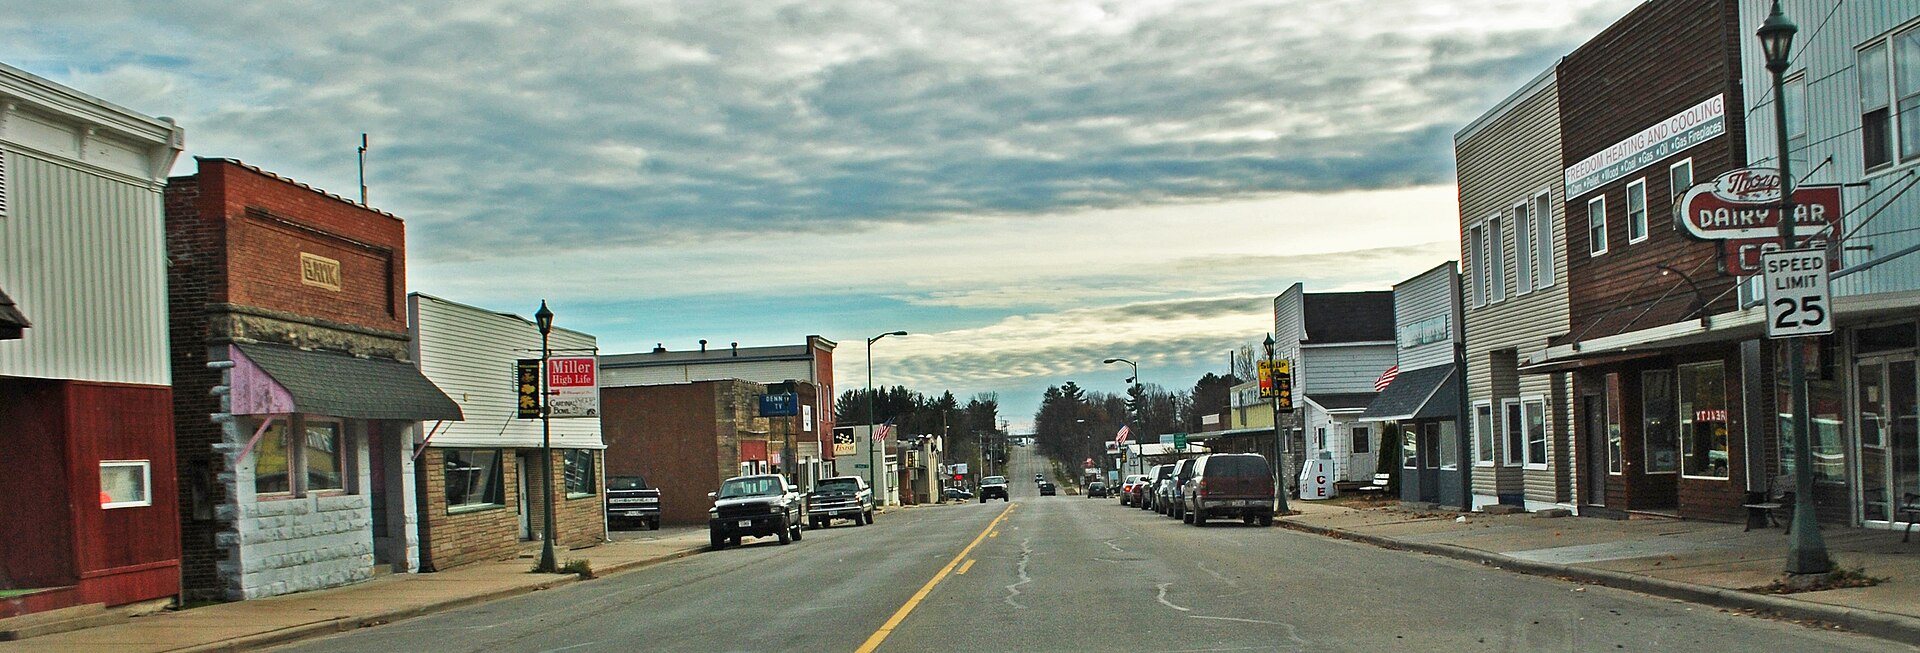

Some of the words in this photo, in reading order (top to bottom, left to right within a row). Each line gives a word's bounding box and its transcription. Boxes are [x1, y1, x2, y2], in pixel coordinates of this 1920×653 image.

[1566, 155, 1603, 182] FREEDOM
[1606, 135, 1645, 164] HEATING
[1648, 123, 1668, 146] AND
[1671, 97, 1721, 134] COOLING
[1605, 166, 1619, 180] Wood
[1624, 157, 1636, 172] Coal
[1642, 150, 1653, 163] Gas
[1660, 142, 1669, 155] Oil
[1674, 135, 1687, 150] Gas
[1688, 120, 1722, 144] Fireplaces
[1727, 171, 1781, 193] Thorp
[1700, 207, 1769, 228] DAIRY
[302, 260, 338, 286] BANK
[1768, 256, 1823, 273] SPEED
[1775, 274, 1818, 290] LIMIT
[1774, 295, 1825, 329] 25
[552, 360, 591, 374] Miller
[552, 374, 572, 385] High
[575, 374, 591, 384] Life
[1316, 463, 1326, 497] ICE
